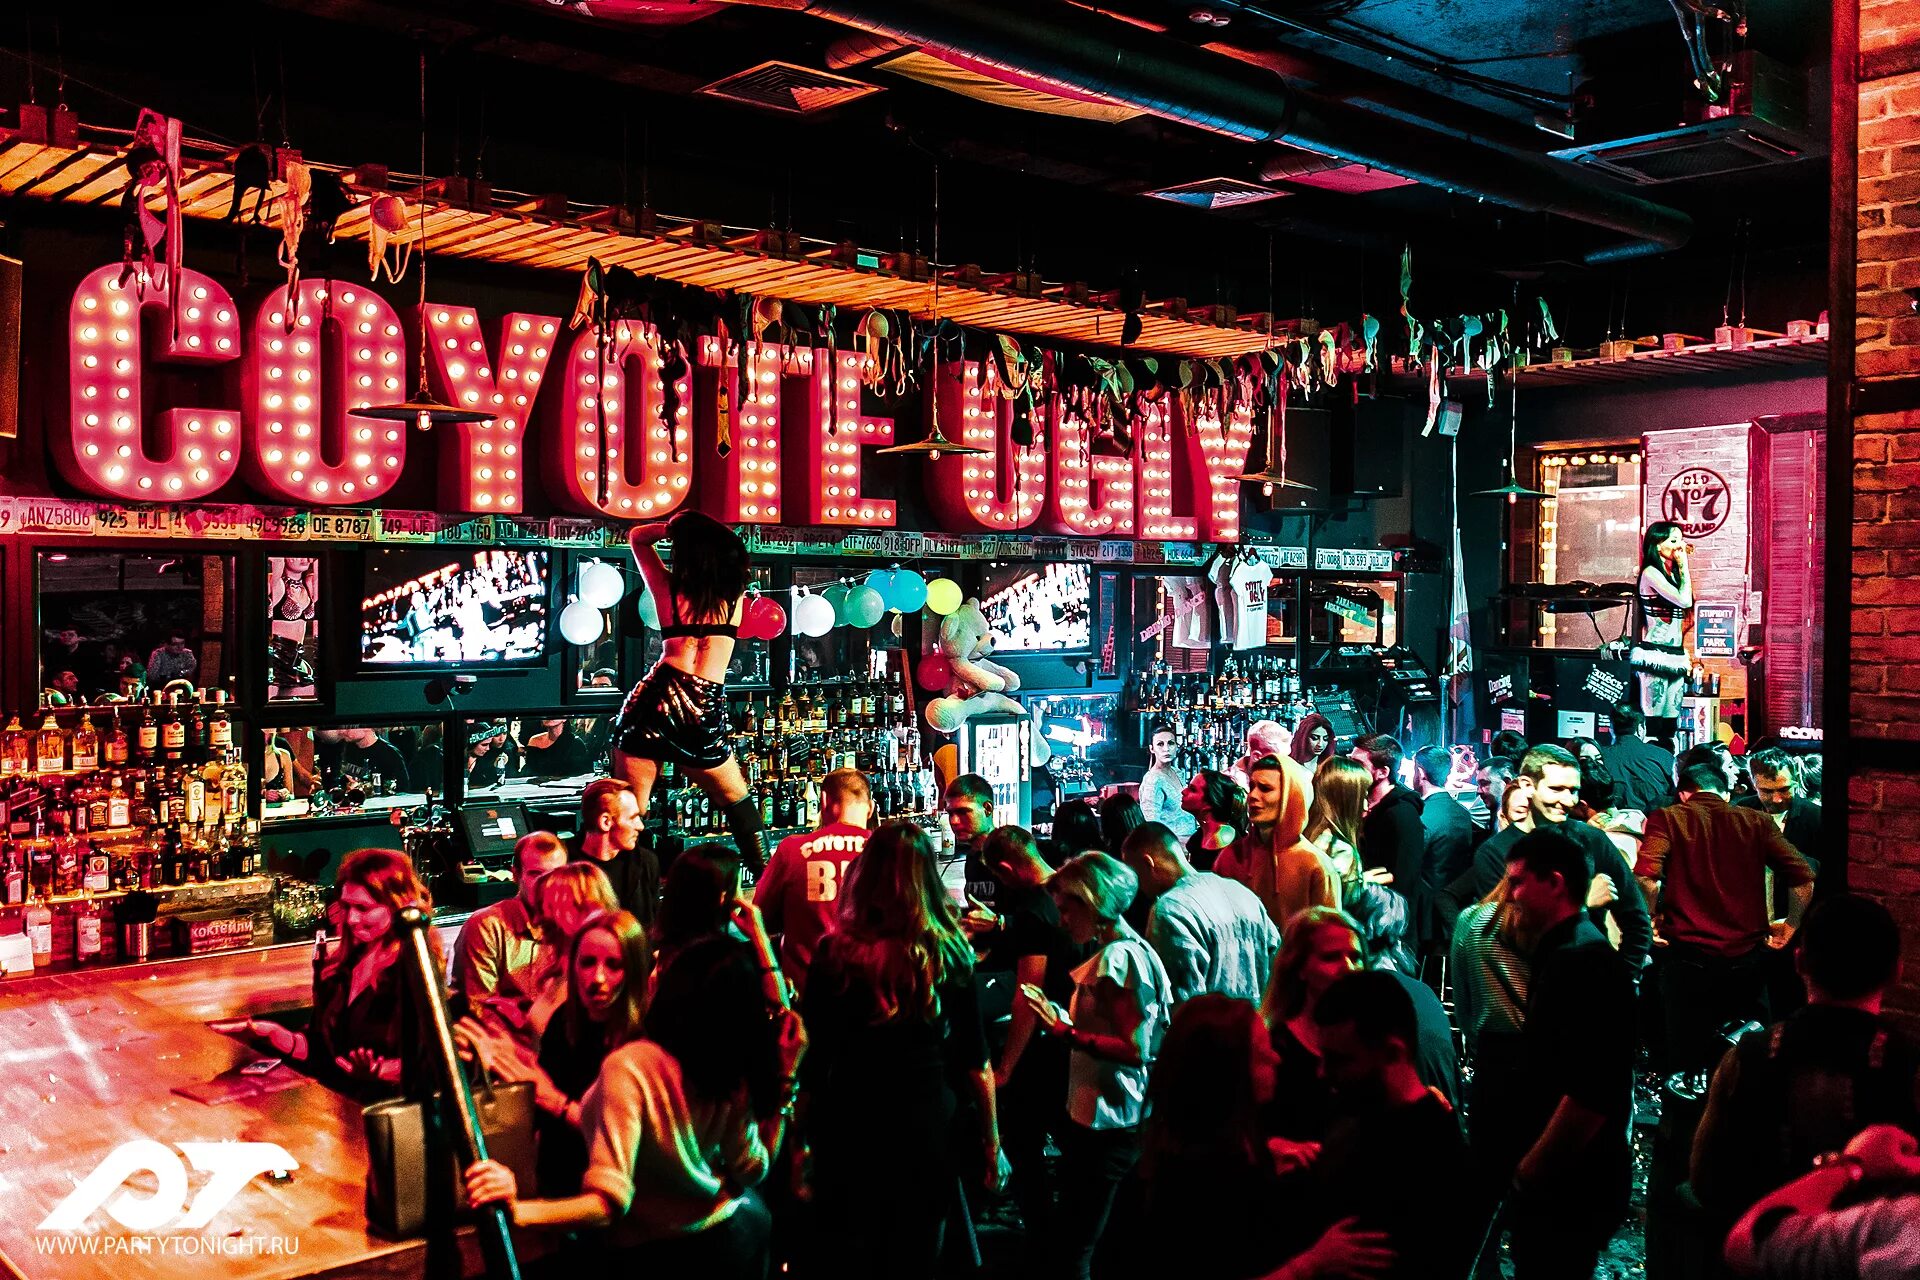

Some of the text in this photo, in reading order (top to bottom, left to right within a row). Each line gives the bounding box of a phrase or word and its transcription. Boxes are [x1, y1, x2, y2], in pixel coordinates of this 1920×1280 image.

[66, 260, 1255, 543] COYOTE UGLY
[27, 506, 90, 526] ANZ5806
[98, 511, 167, 530] 925 MJL
[335, 518, 370, 534] 8787
[1699, 609, 1734, 618] STUPIDITY
[1703, 637, 1727, 647] PARK
[801, 834, 865, 859] COYOTE
